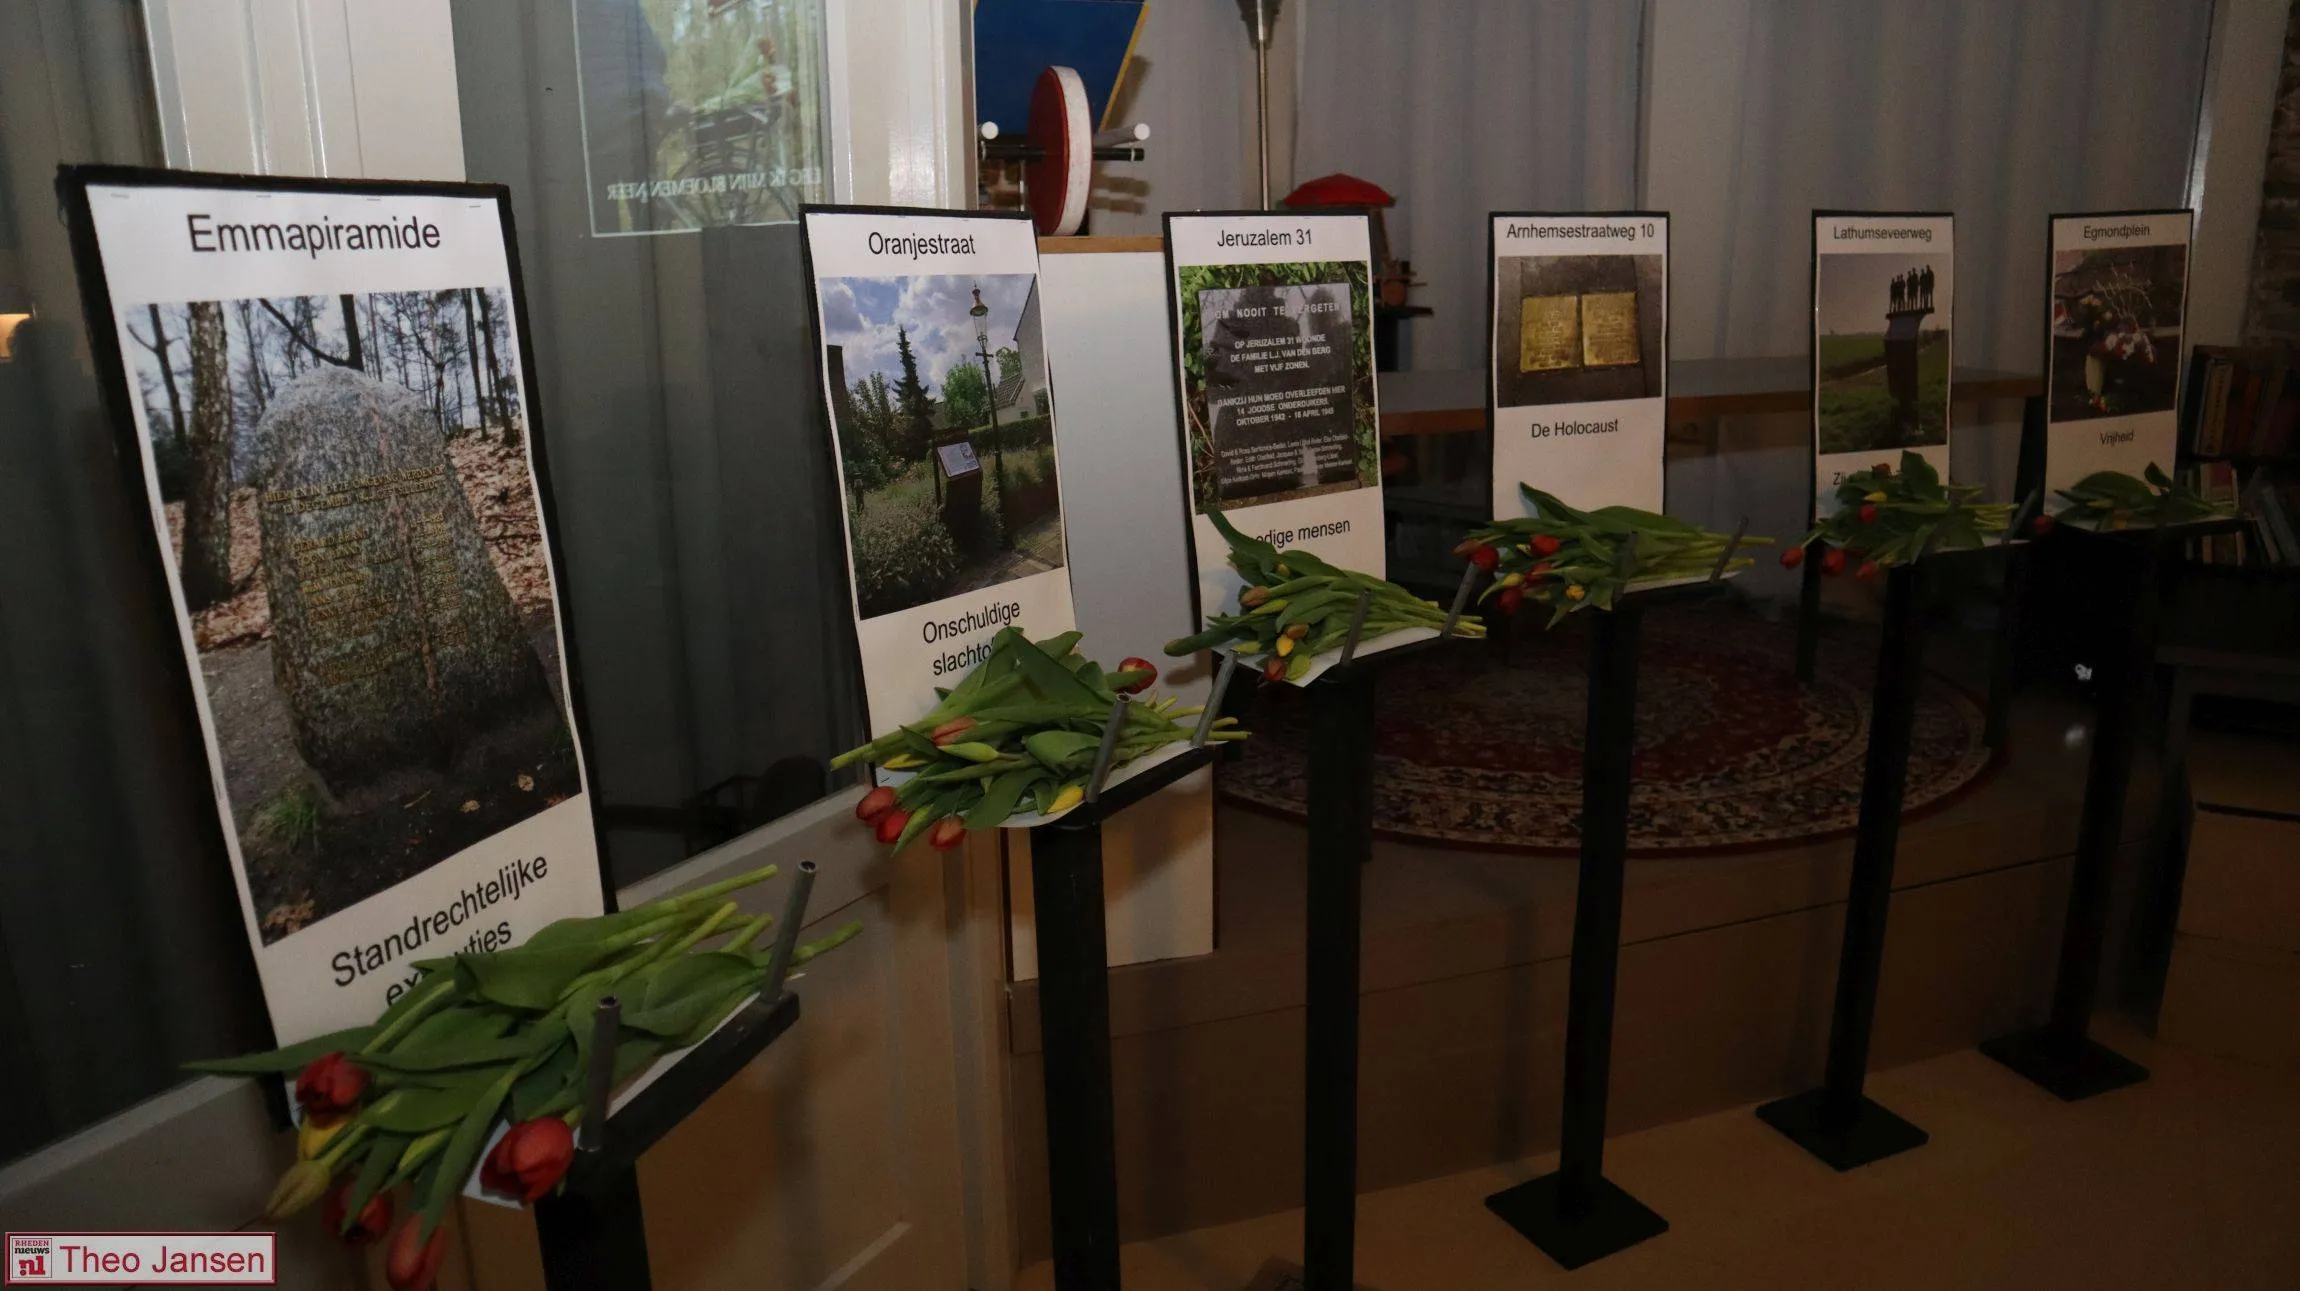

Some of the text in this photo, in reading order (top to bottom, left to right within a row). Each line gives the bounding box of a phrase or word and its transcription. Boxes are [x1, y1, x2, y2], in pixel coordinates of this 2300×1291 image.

[186, 213, 442, 260] Emmapiramide
[1217, 228, 1312, 247] Jeruzalem 31
[1506, 223, 1655, 241] Arnhemsestraatweg 10
[1833, 226, 1933, 243] Lathumseveerweg
[2083, 223, 2151, 241] Egmondplein
[868, 231, 977, 261] Oranjestraat
[1214, 302, 1340, 319] OM NOOIT TE RGETEN
[1234, 340, 1246, 349] OP
[1246, 336, 1287, 348] JERUZALEM
[1287, 336, 1296, 345] 31
[1230, 354, 1241, 363] DE
[1241, 351, 1269, 361] FAMILIE
[1281, 350, 1298, 359] VAN
[1297, 348, 1313, 357] DEN
[1312, 345, 1332, 356] BERG
[1254, 363, 1269, 373] MET
[1236, 414, 1270, 427] OKTOBER
[1531, 419, 1618, 438] De Holocaust
[1256, 520, 1351, 549] dige mensen
[923, 602, 1020, 644] Onschuldige
[933, 637, 996, 676] slachto
[332, 856, 548, 987] Standrechtelijke
[386, 920, 512, 1006] exties
